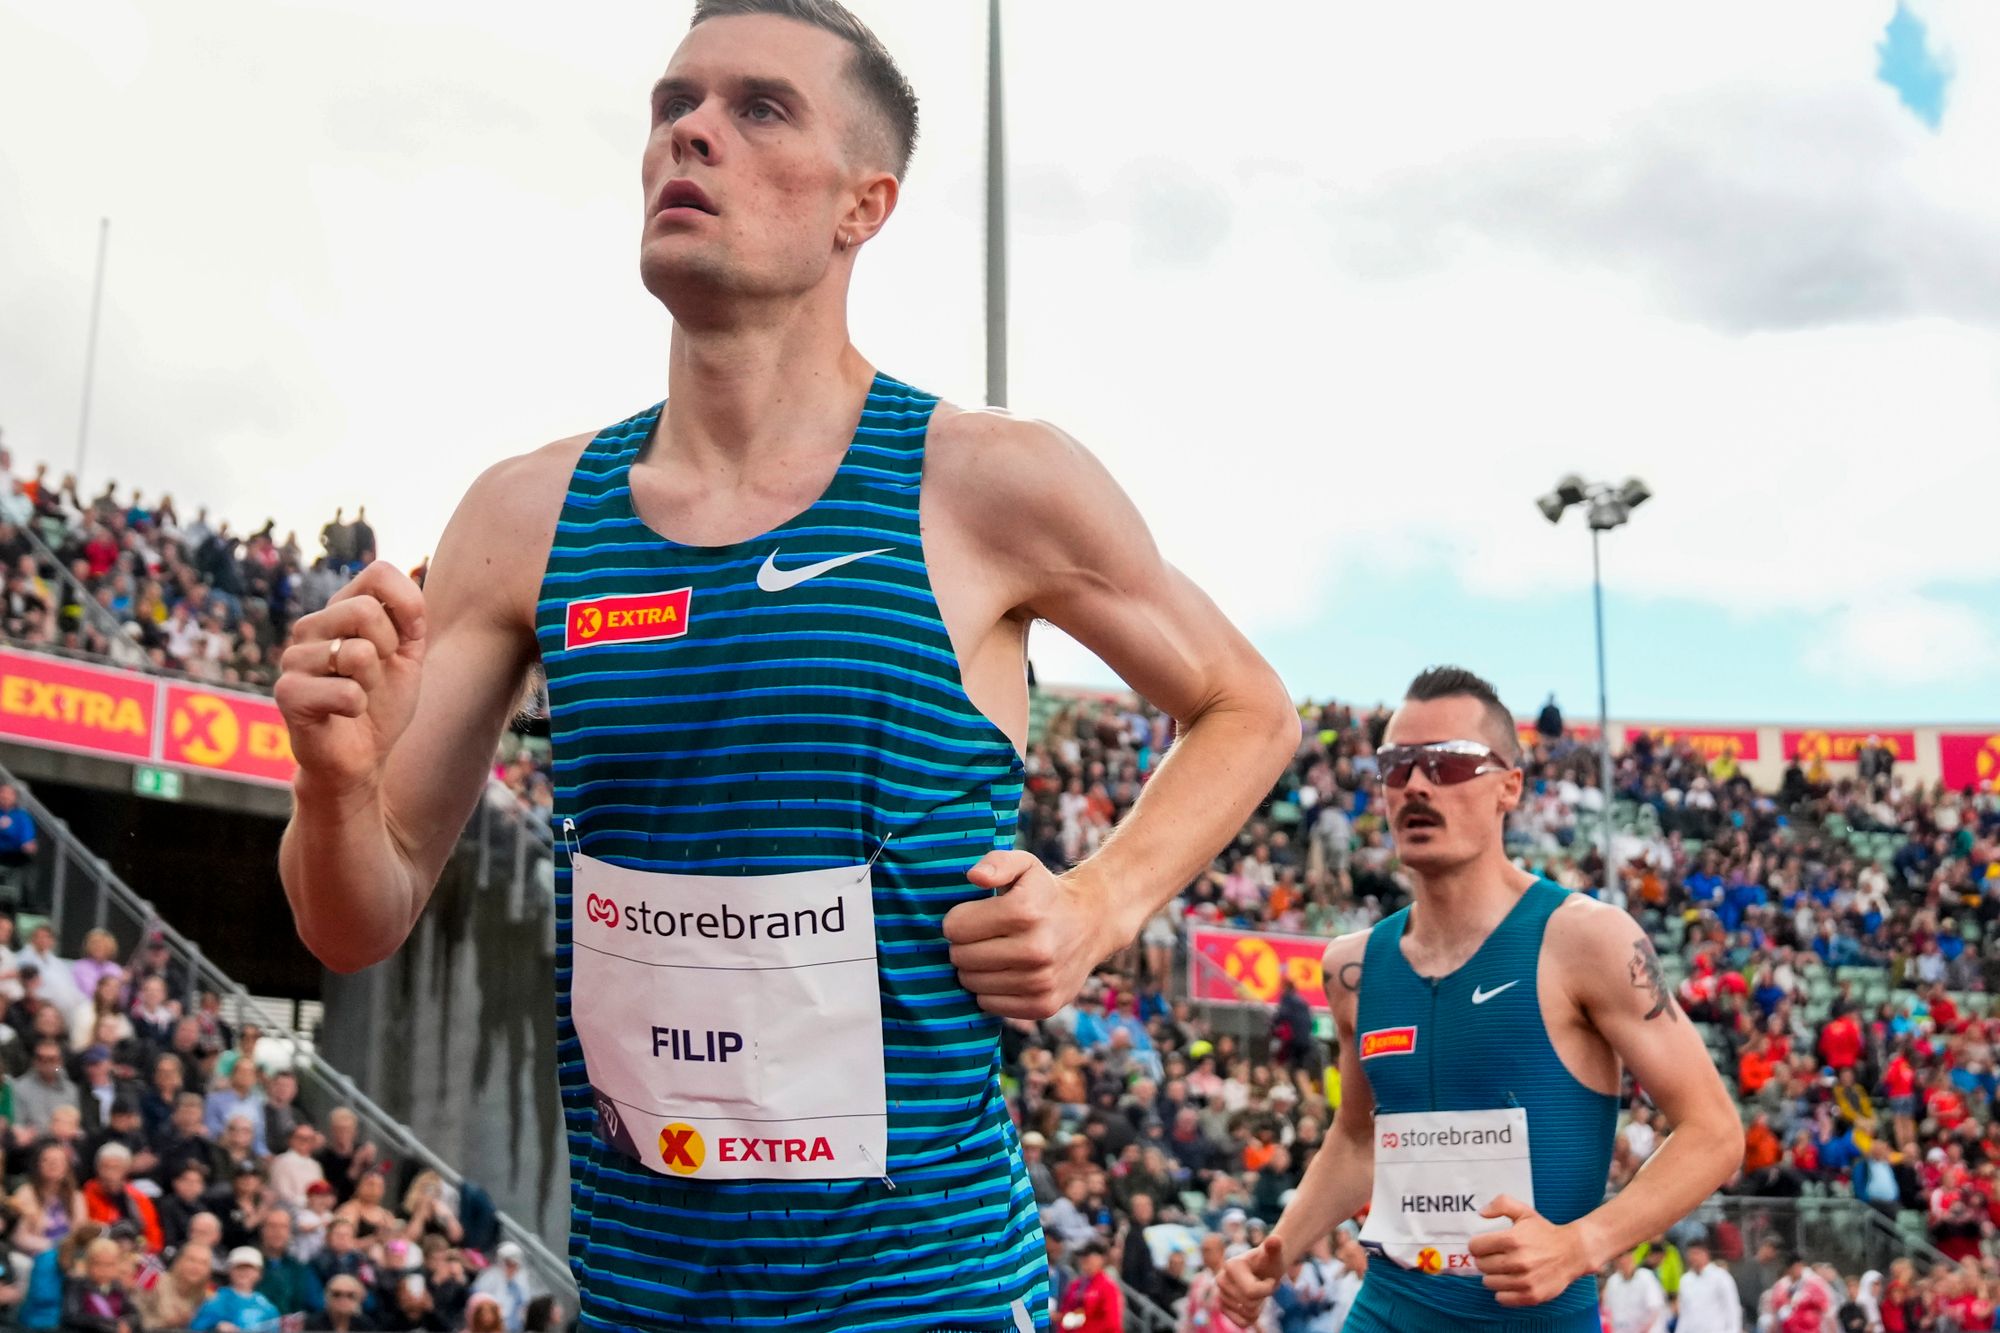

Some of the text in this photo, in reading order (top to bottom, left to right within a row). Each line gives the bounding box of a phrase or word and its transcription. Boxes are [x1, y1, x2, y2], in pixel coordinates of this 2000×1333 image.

[607, 605, 677, 628] EXTRA
[1, 675, 146, 736] EXTRA
[624, 896, 846, 940] storebrand
[651, 1025, 743, 1062] FILIP
[1401, 1124, 1513, 1147] storebrand
[718, 1136, 835, 1163] EXTRA
[1401, 1194, 1477, 1213] HENRIK
